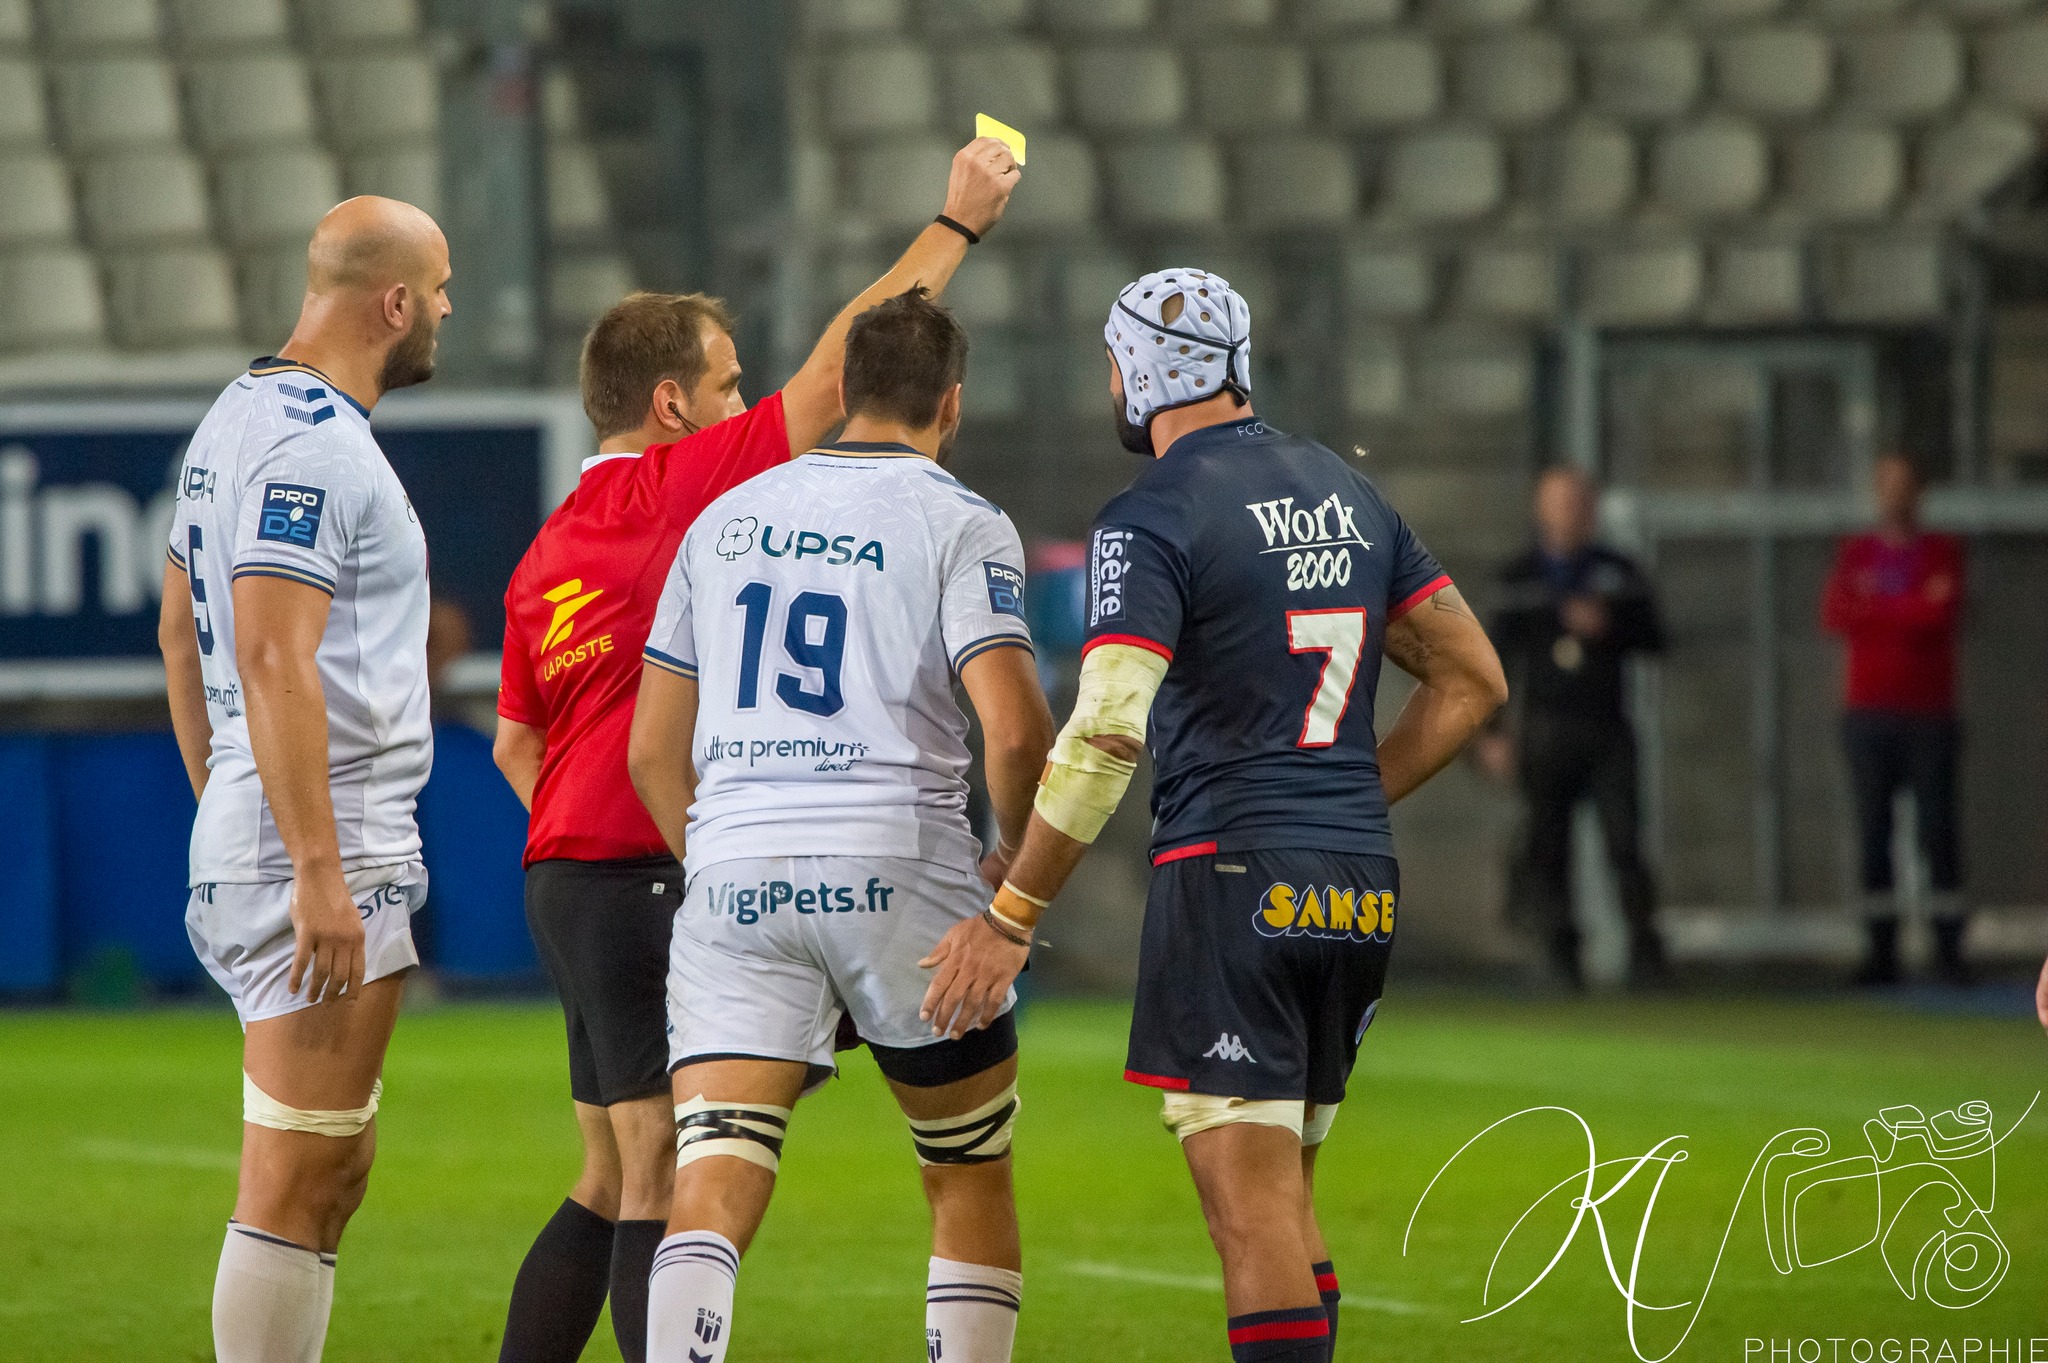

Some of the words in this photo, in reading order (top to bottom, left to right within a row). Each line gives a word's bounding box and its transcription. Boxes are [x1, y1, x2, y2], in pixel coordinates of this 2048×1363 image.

[1236, 422, 1264, 437] FCG
[269, 489, 318, 507] PRO
[264, 515, 312, 541] D2
[1246, 492, 1371, 550] Work
[761, 525, 885, 572] UPSA
[1286, 548, 1352, 592] 2000
[188, 524, 215, 656] 5
[990, 566, 1023, 588] PRO
[1100, 531, 1134, 617] isère
[735, 581, 848, 718] 19
[1286, 607, 1366, 748] 7
[703, 735, 744, 761] ultra
[750, 736, 866, 767] premium
[814, 757, 863, 772] direct
[707, 877, 895, 925] VigiPets.fr
[1258, 883, 1395, 938] SAMSE
[697, 1307, 723, 1325] SUA
